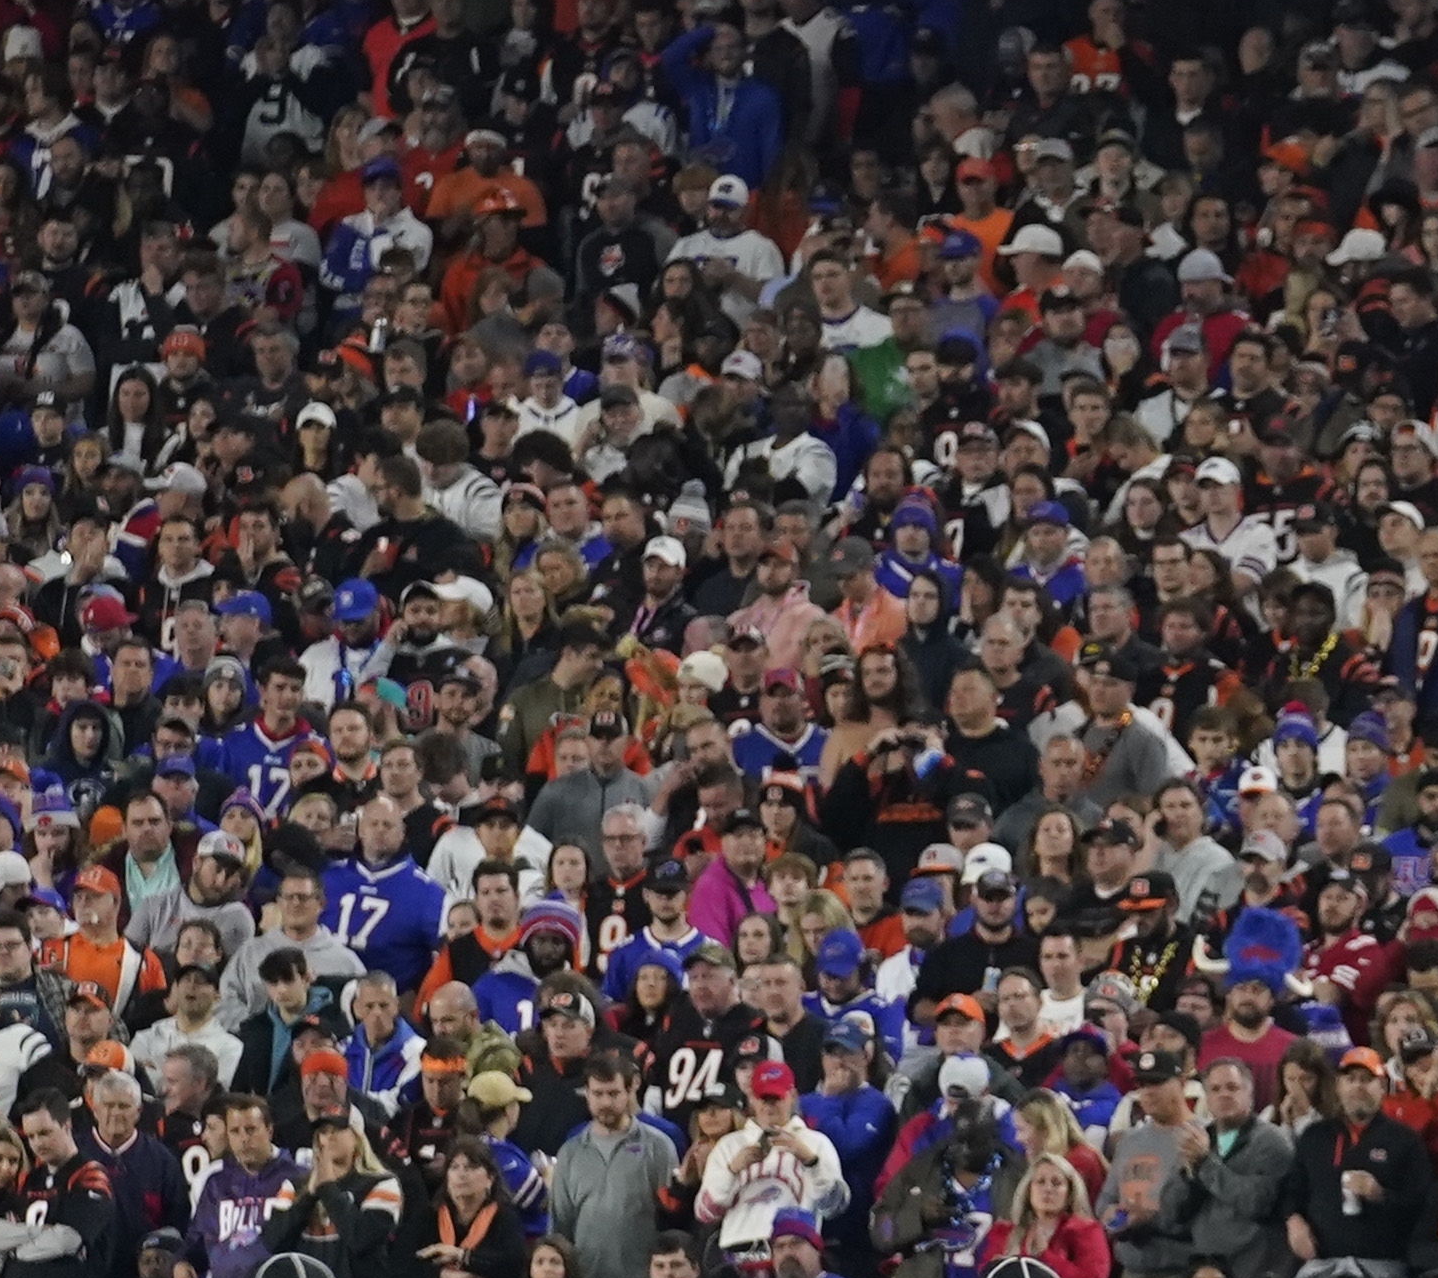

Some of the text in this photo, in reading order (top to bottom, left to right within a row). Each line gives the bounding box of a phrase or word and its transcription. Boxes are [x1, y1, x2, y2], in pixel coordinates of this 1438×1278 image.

[247, 767, 289, 817] 17
[338, 892, 391, 947] 17
[665, 1050, 725, 1108] 94
